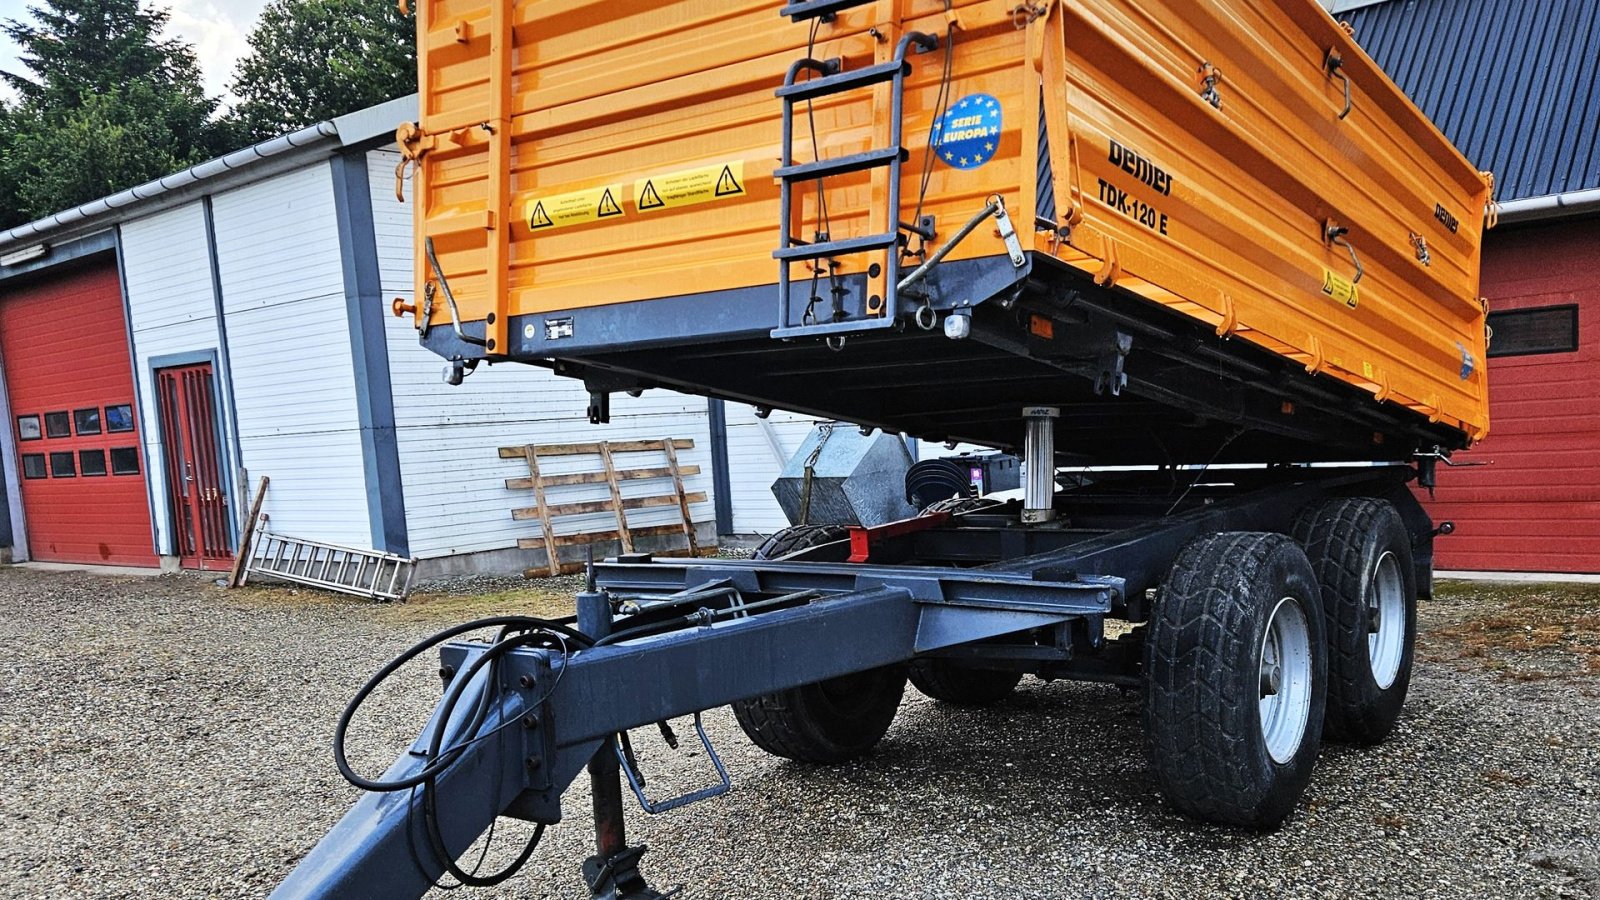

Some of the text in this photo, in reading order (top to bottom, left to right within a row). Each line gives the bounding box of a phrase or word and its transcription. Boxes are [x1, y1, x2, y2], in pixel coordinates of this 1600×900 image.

[951, 115, 983, 129] SERIE
[943, 127, 988, 143] EUROPA
[1098, 178, 1168, 236] TDK-120 E
